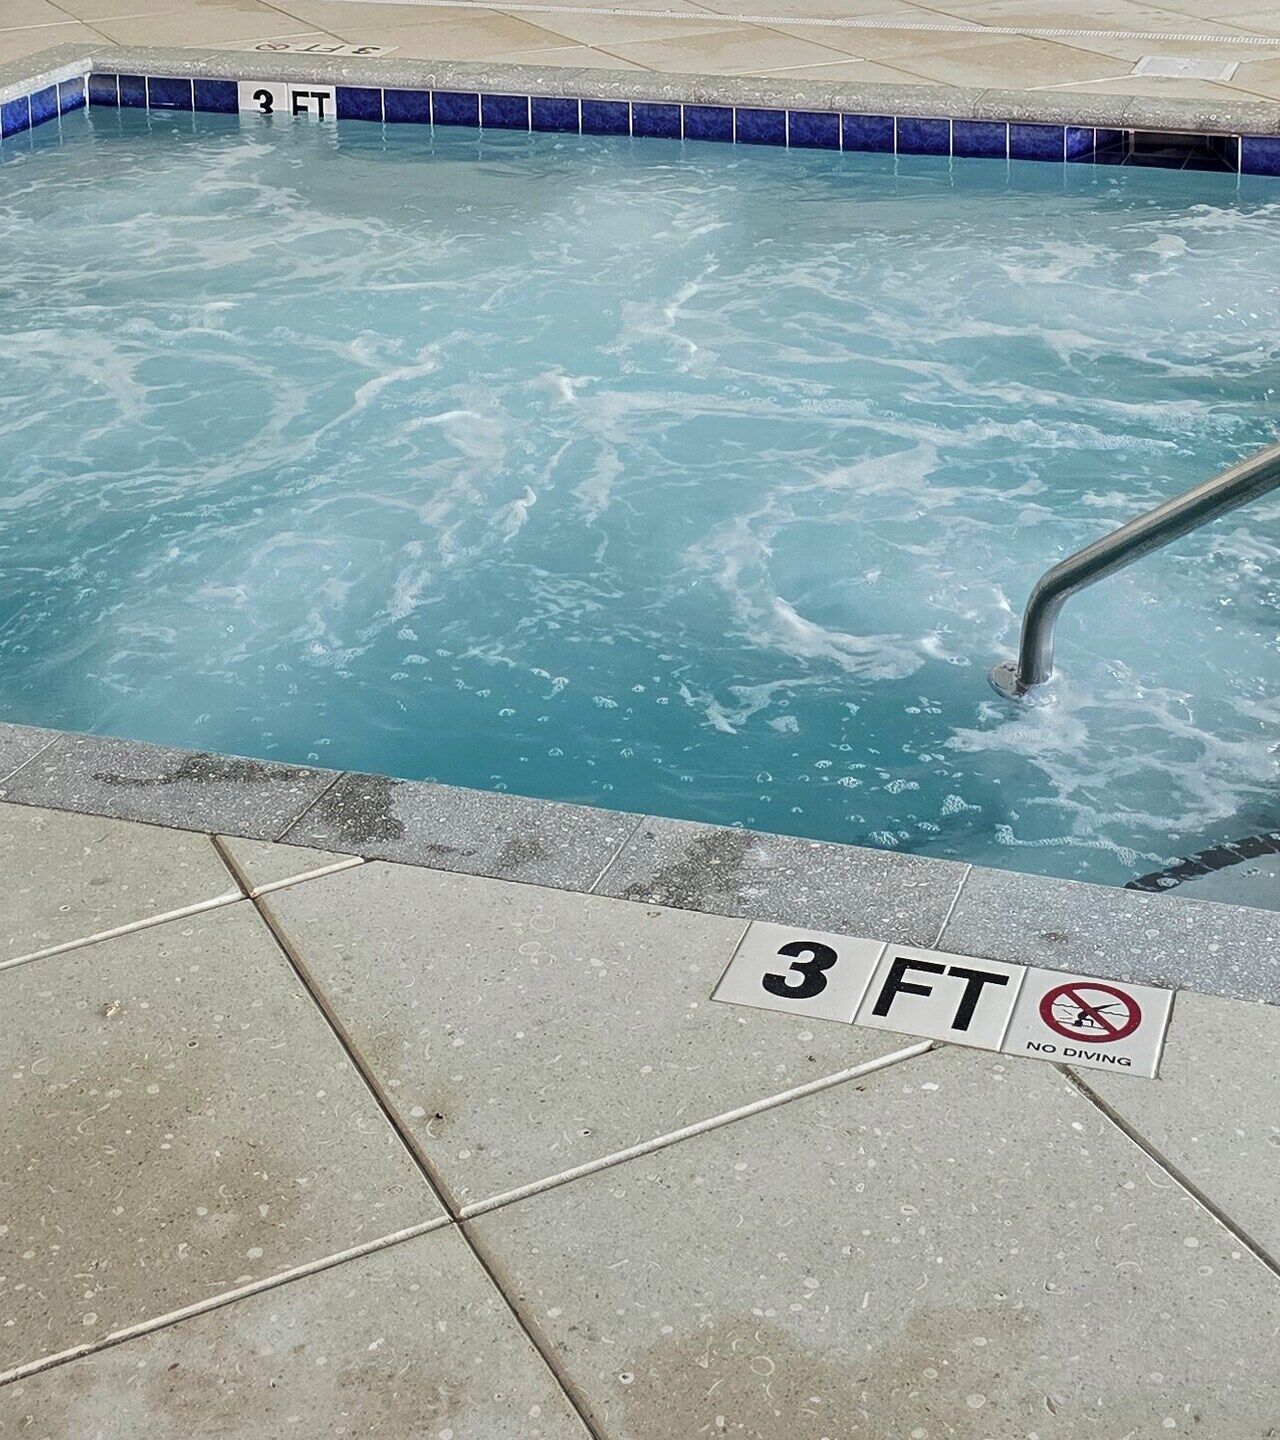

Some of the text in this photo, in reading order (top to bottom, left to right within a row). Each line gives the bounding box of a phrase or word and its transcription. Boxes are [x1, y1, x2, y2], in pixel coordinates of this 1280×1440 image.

[252, 88, 331, 120] 3 FT
[761, 940, 1010, 1032] 3 FT
[1026, 1041, 1133, 1067] NO DIVING
